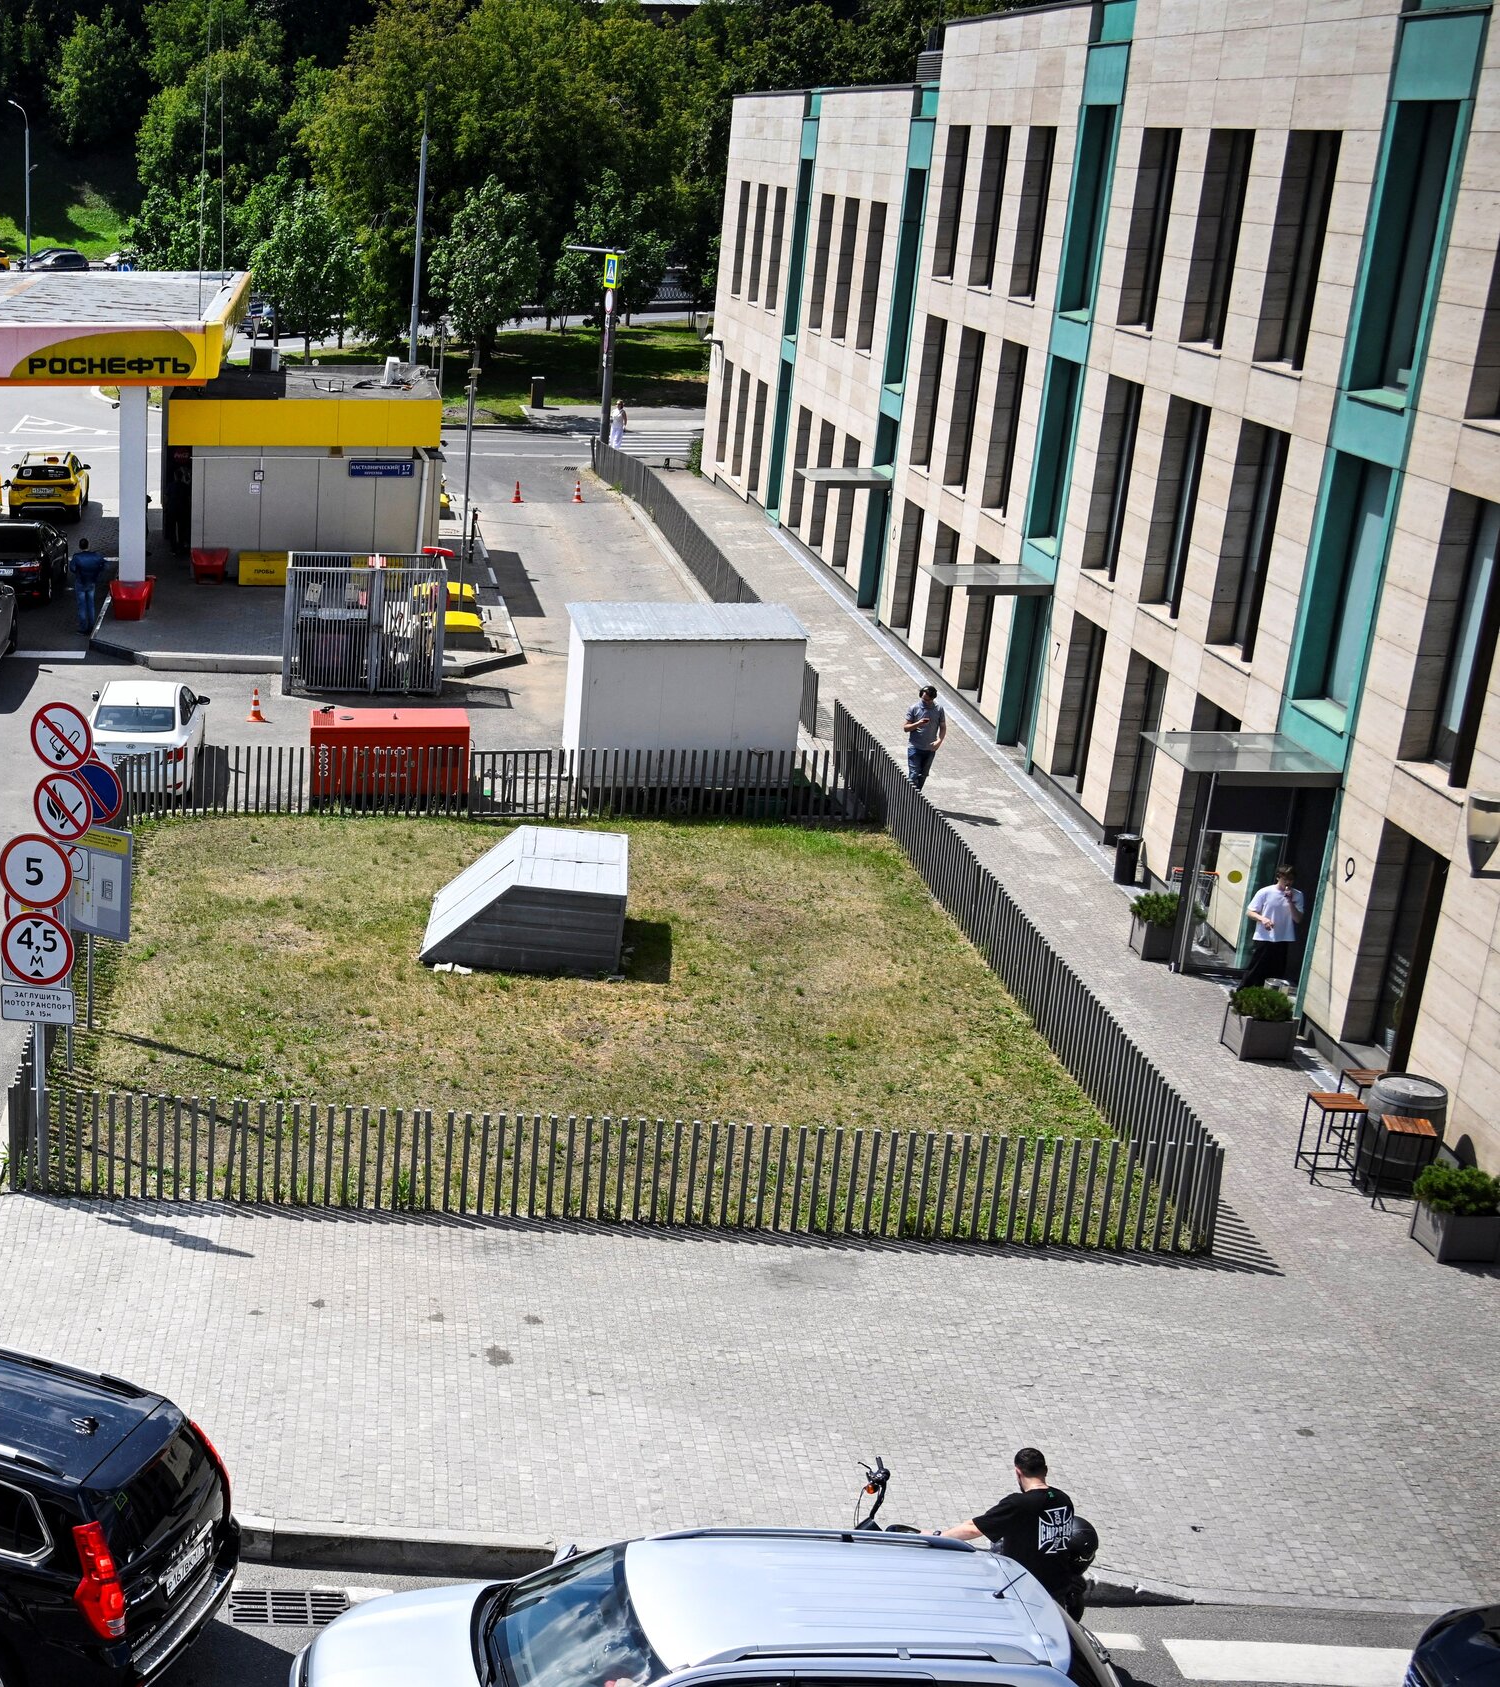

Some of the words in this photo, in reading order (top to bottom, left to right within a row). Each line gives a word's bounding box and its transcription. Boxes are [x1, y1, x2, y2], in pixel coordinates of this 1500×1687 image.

[28, 356, 192, 375] РОСНЕФТЬ
[1054, 642, 1061, 661] 7
[25, 857, 44, 886] 5
[16, 927, 58, 955] 4,5
[3, 1000, 72, 1011] МОТОТРАНСПОРТ
[14, 991, 62, 1002] ЗАГЛУШИТЬ
[25, 1009, 35, 1017] ЗА
